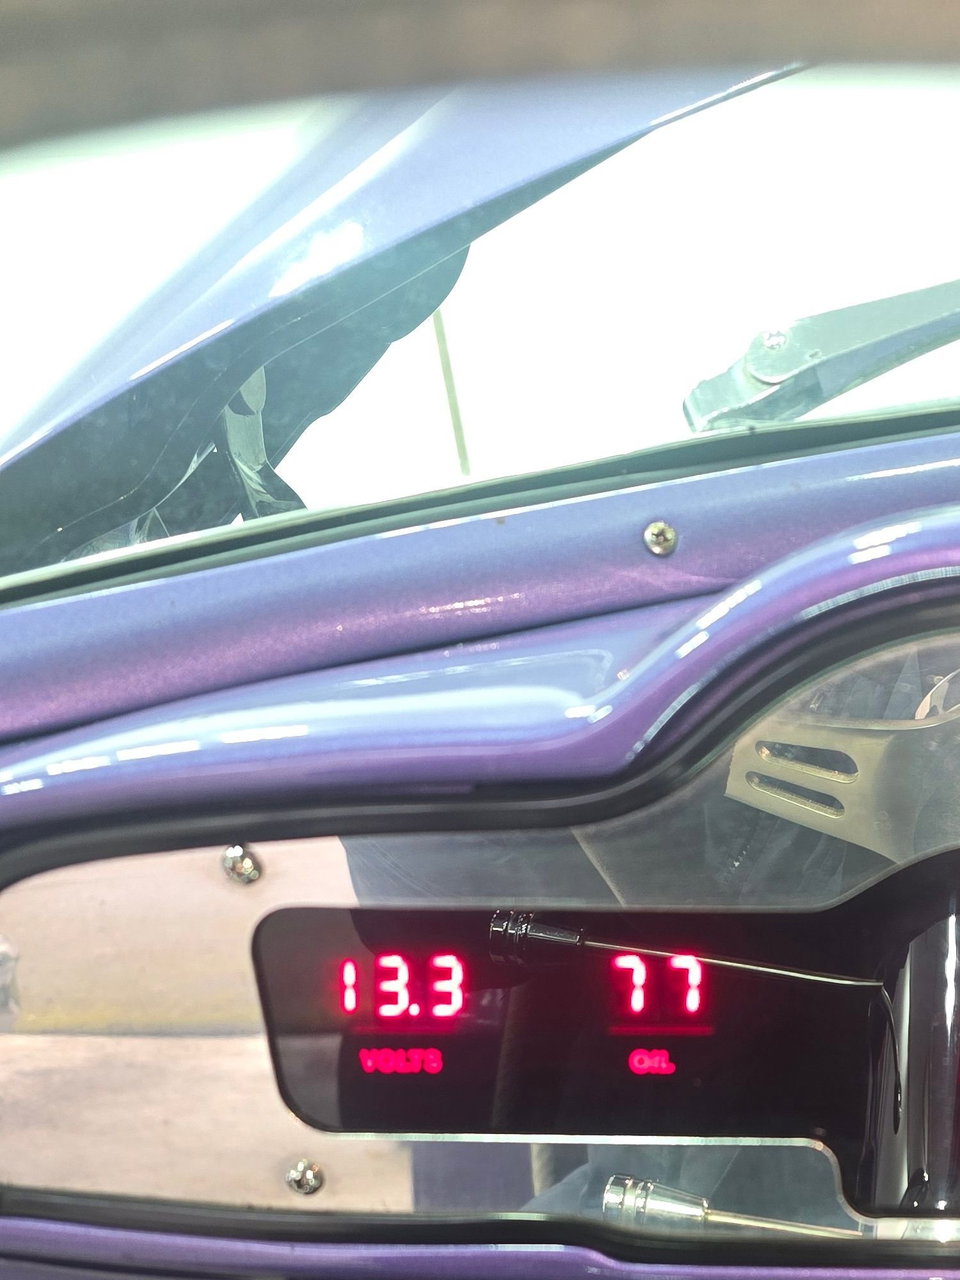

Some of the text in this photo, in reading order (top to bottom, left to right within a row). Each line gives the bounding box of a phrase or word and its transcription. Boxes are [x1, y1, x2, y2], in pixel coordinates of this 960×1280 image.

[340, 954, 465, 1017] 13.3
[611, 953, 703, 1014] 77
[359, 1048, 443, 1074] VOLTS
[628, 1048, 676, 1074] OIL
